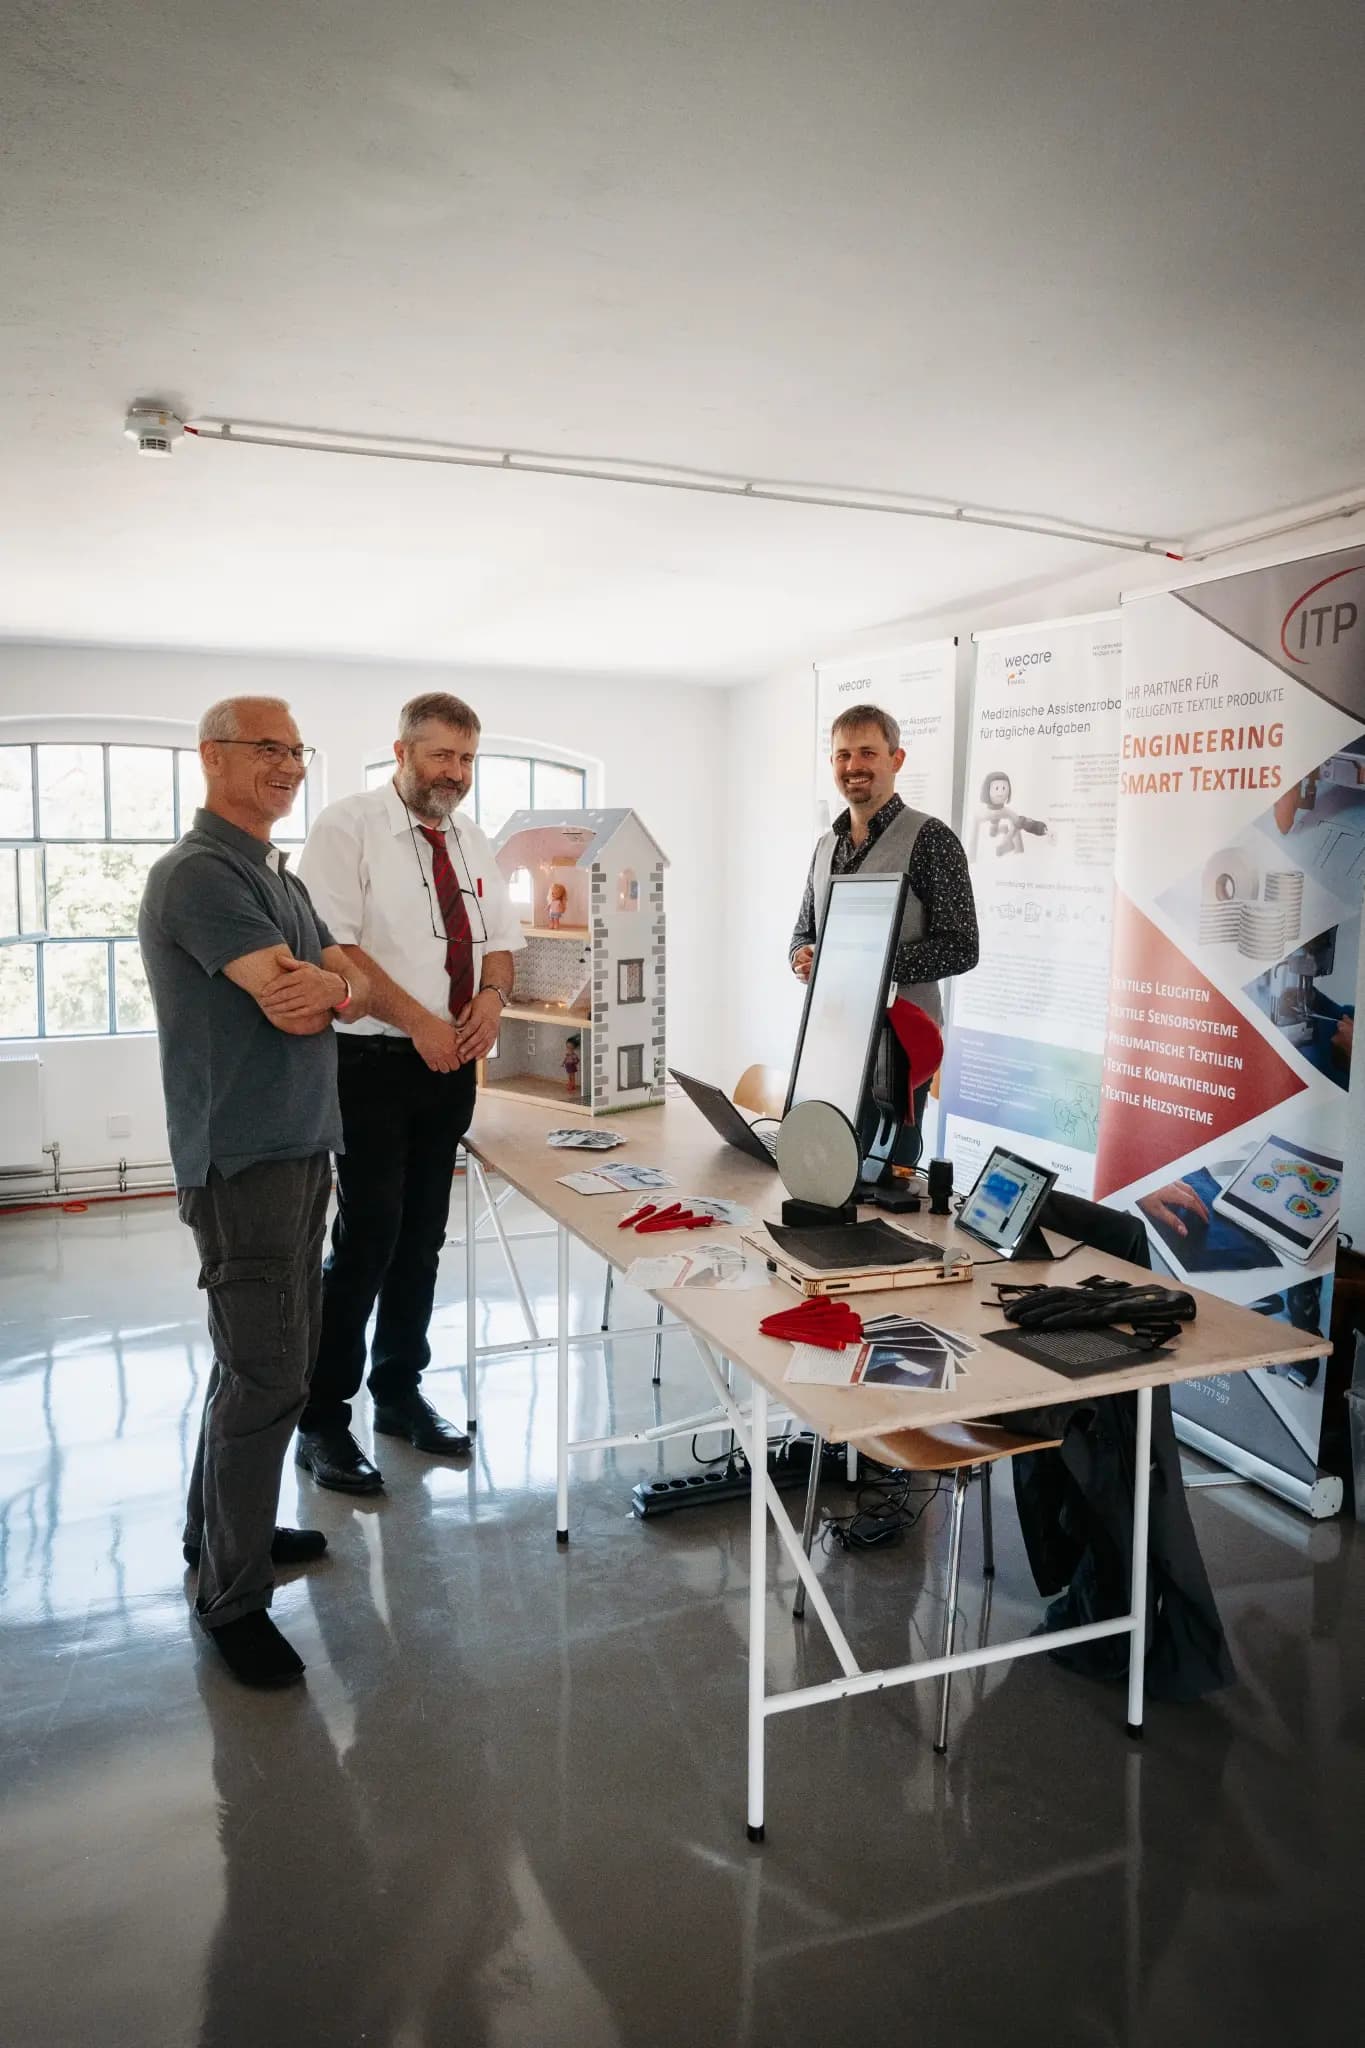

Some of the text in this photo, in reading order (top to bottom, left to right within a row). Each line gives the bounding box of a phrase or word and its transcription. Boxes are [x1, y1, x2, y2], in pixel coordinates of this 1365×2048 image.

[1299, 602, 1358, 649] ITP
[1004, 650, 1053, 668] wecare
[838, 676, 873, 693] wecare
[1125, 671, 1219, 701] IHR PARTNER FÜR
[981, 697, 1122, 721] Medizinische Assistenzrobo
[1126, 687, 1285, 720] NTELLIGENTE TEXTILE PRODUKTE
[980, 721, 1092, 740] für tägliche Aufgaben
[1122, 722, 1285, 759] ENGINEERING
[1120, 771, 1184, 795] SMART
[1189, 764, 1282, 792] TEXTILES
[1155, 981, 1210, 1003] LEUCHTEN
[1110, 1003, 1239, 1039] TEXTILE SENSORSYSTEME
[1108, 1031, 1243, 1070] PNEUMATISCHE TEXTILIEN
[1107, 1057, 1236, 1100] TEXTILE KONTAKTIERUNG
[1105, 1084, 1214, 1125] TEXTILE HEIZSYSTEME
